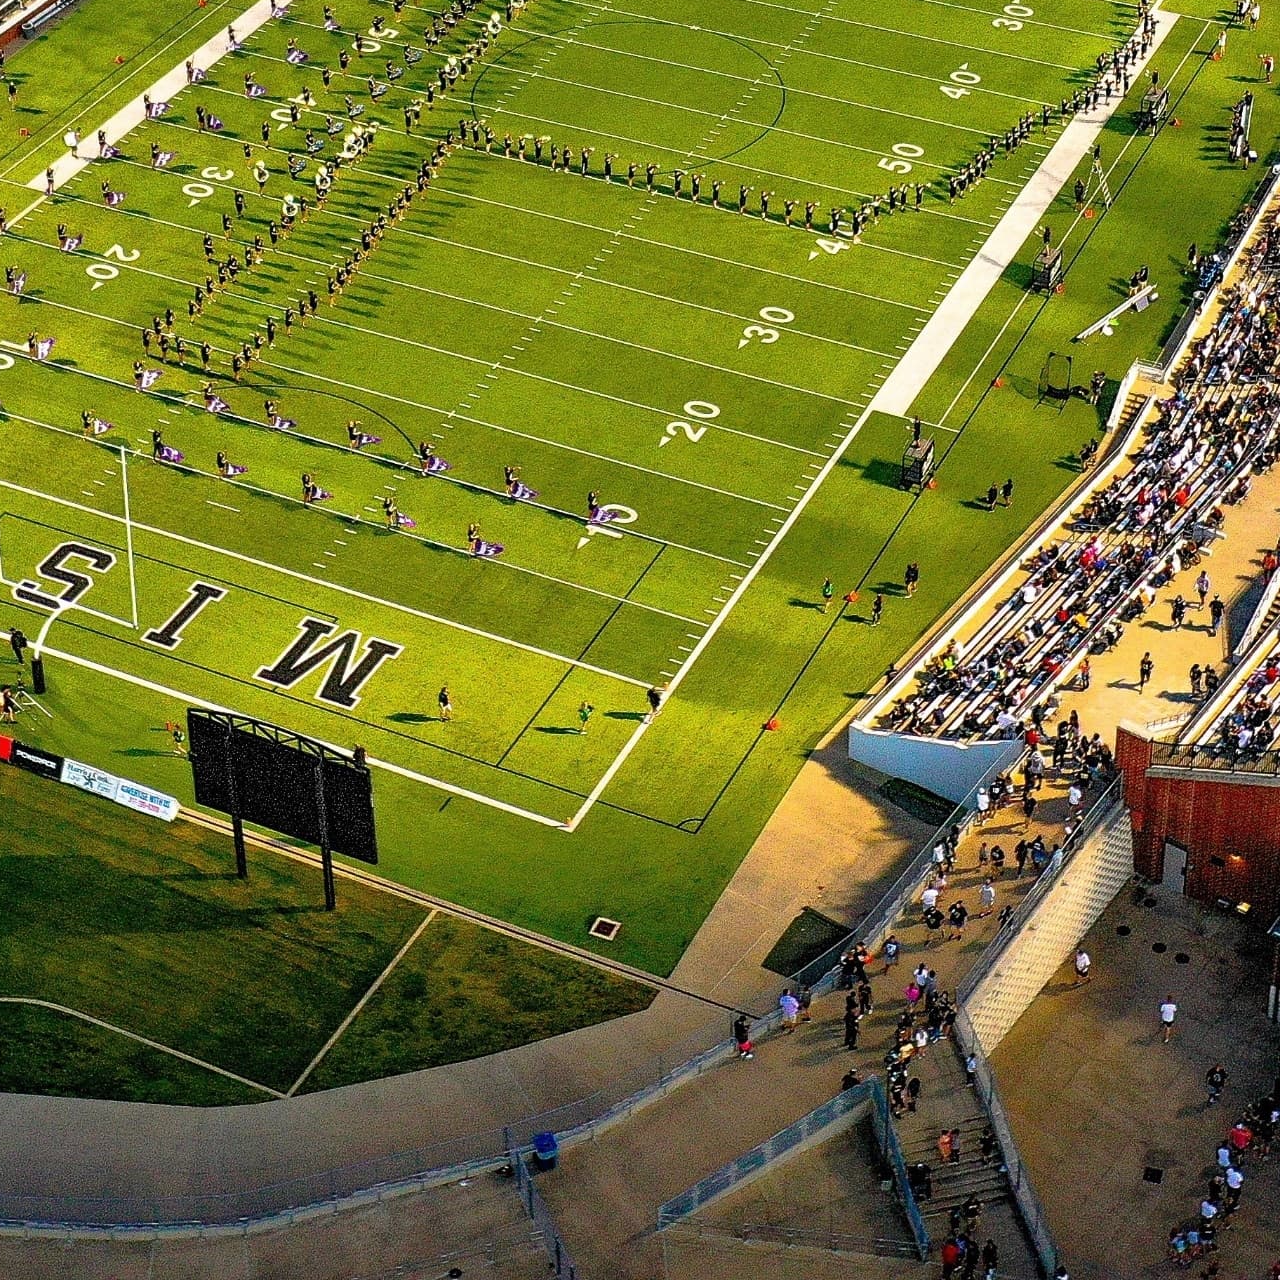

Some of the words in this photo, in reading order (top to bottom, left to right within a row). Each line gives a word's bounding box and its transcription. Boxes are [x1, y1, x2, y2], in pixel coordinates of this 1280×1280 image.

[992, 4, 1034, 31] 30
[939, 71, 981, 100] 40
[877, 143, 924, 174] 50
[182, 166, 234, 197] 30
[86, 244, 141, 280] 20
[743, 306, 795, 344] 30
[666, 400, 721, 443] 20
[585, 503, 639, 539] 10
